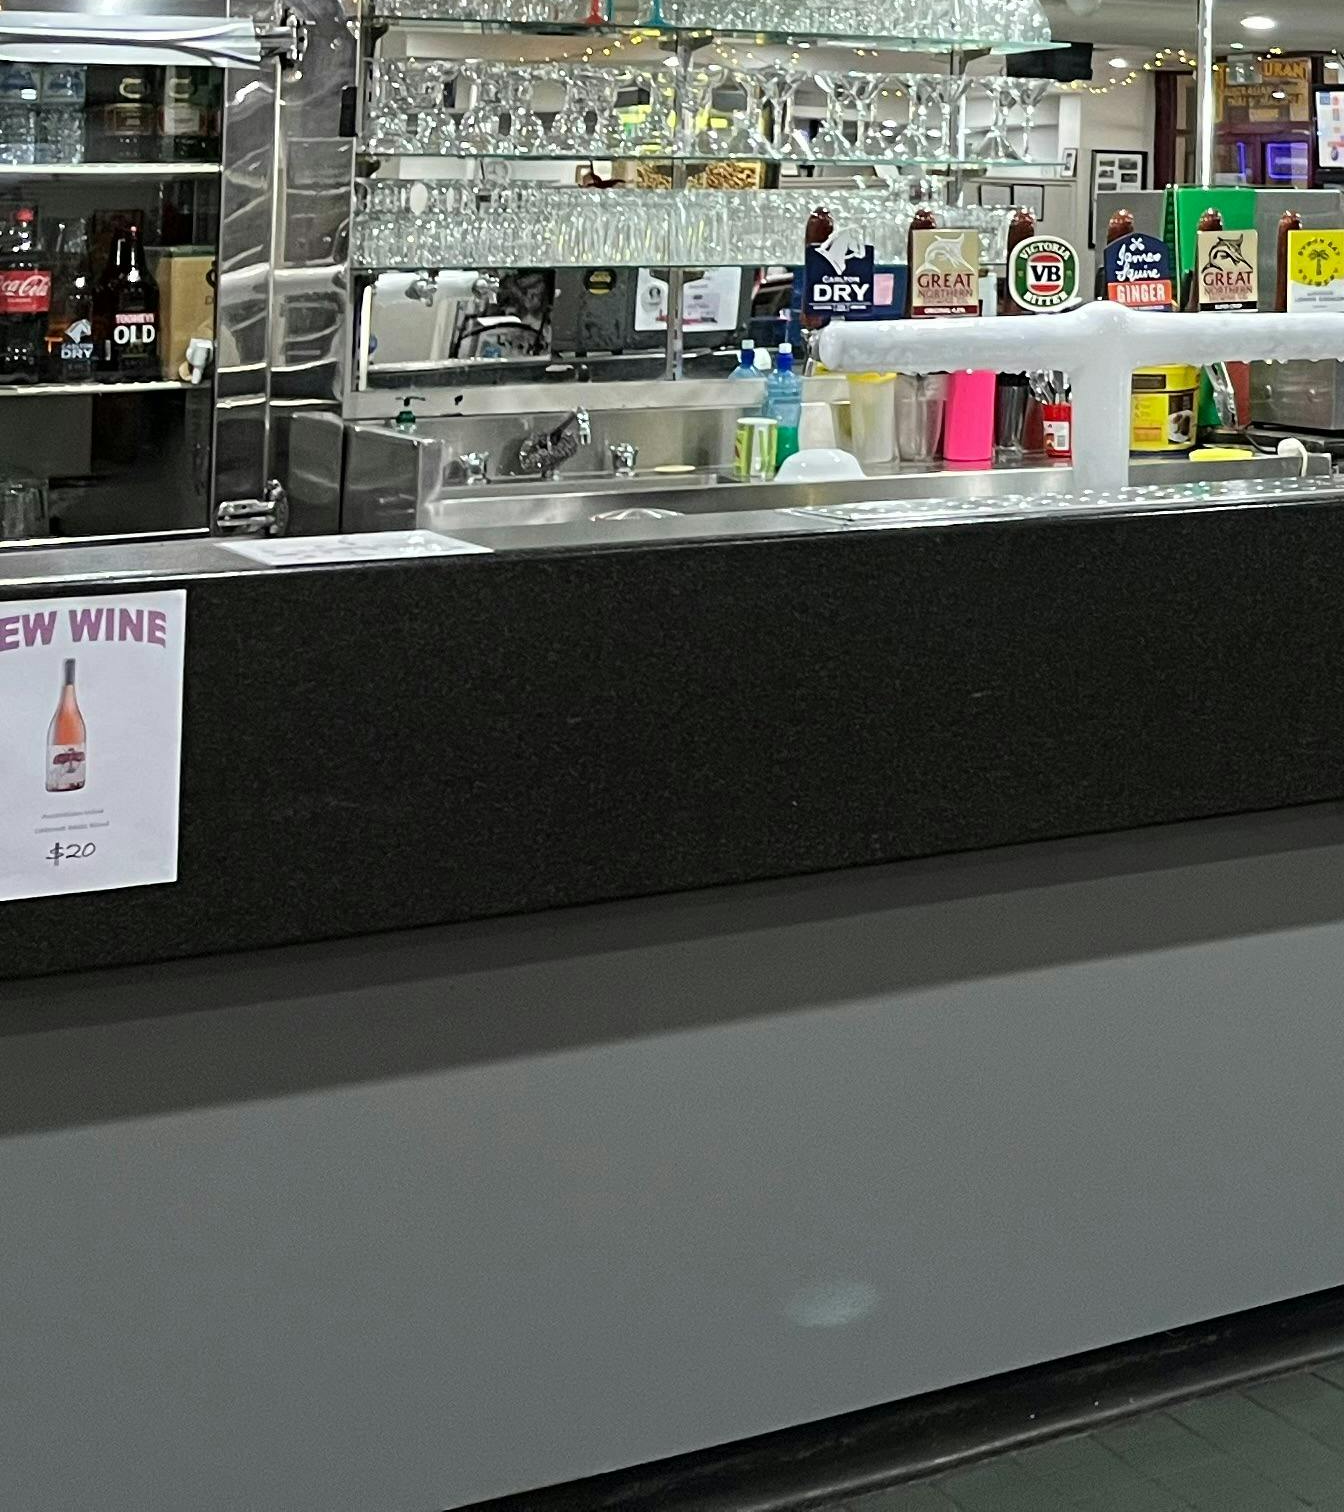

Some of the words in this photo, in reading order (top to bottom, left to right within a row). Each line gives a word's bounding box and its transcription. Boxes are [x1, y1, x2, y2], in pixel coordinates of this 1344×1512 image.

[1017, 238, 1071, 260] VICTORIA
[1115, 241, 1163, 266] James
[917, 273, 974, 289] GREAT
[1031, 264, 1062, 283] VB
[1114, 266, 1161, 283] Squire
[1203, 270, 1254, 286] GREAT
[813, 283, 870, 302] DRY
[917, 288, 973, 300] NORTHERN
[1023, 290, 1070, 306] BITTER
[1116, 283, 1167, 304] GINGER
[113, 324, 156, 345] OLD
[61, 348, 93, 359] DRY
[0, 610, 57, 652] EW
[69, 608, 167, 649] WINE
[46, 842, 97, 866] $20
